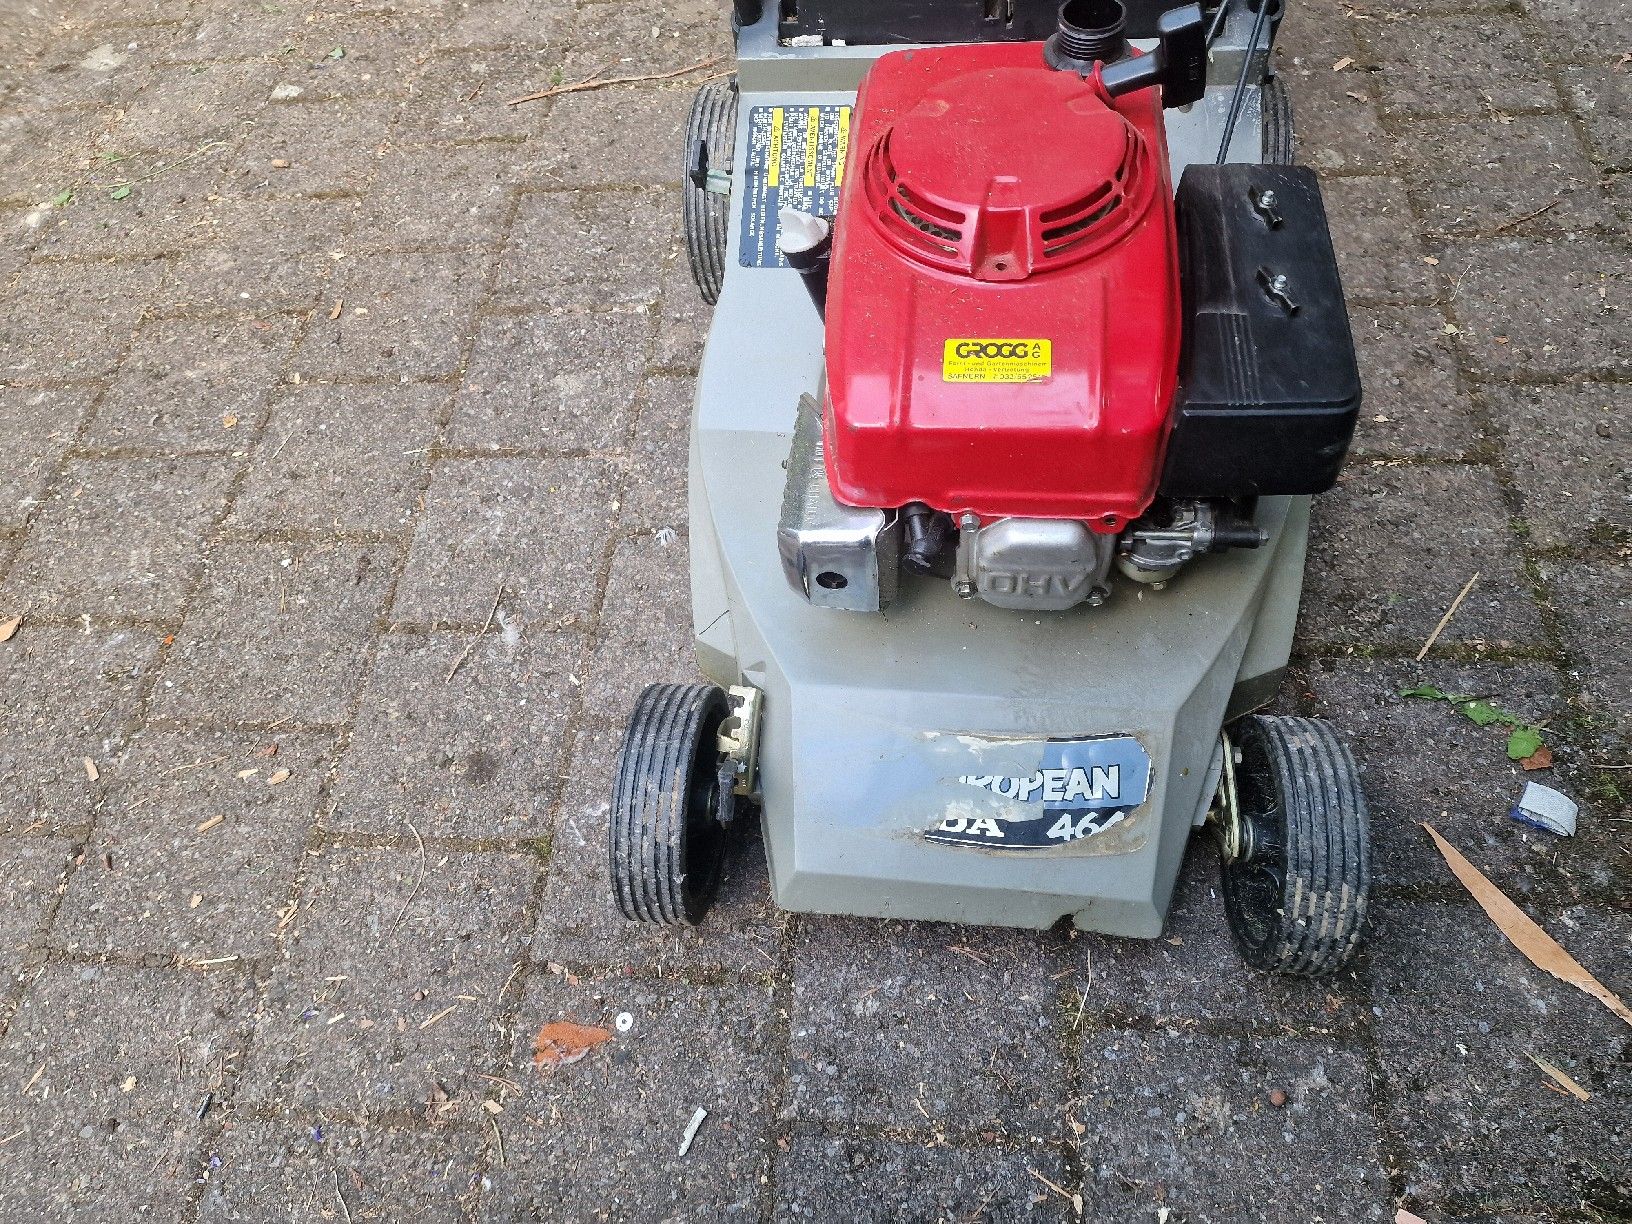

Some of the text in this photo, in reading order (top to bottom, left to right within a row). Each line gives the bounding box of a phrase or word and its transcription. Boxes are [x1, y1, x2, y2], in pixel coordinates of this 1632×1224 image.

[956, 342, 1029, 359] GROGG
[984, 571, 1092, 597] OHV
[958, 764, 1121, 803] OPEAN
